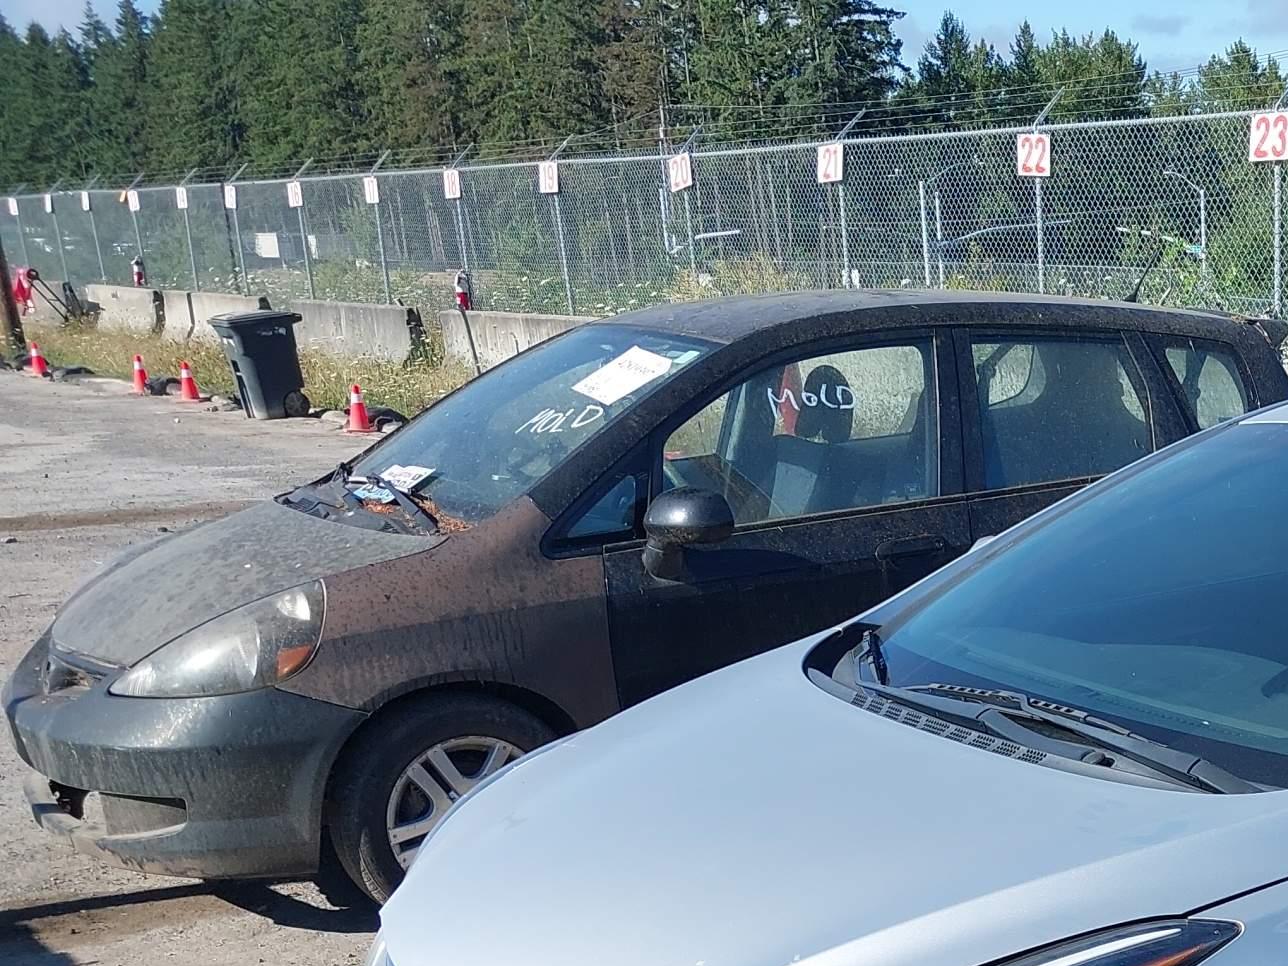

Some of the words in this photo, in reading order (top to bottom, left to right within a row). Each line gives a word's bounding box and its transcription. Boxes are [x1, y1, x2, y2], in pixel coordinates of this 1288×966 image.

[1254, 115, 1288, 157] 23
[823, 147, 838, 180] 21
[1021, 136, 1046, 173] 22
[446, 171, 457, 197] 18
[542, 162, 555, 190] 19
[671, 157, 690, 188] 20
[515, 405, 604, 434] MOLD
